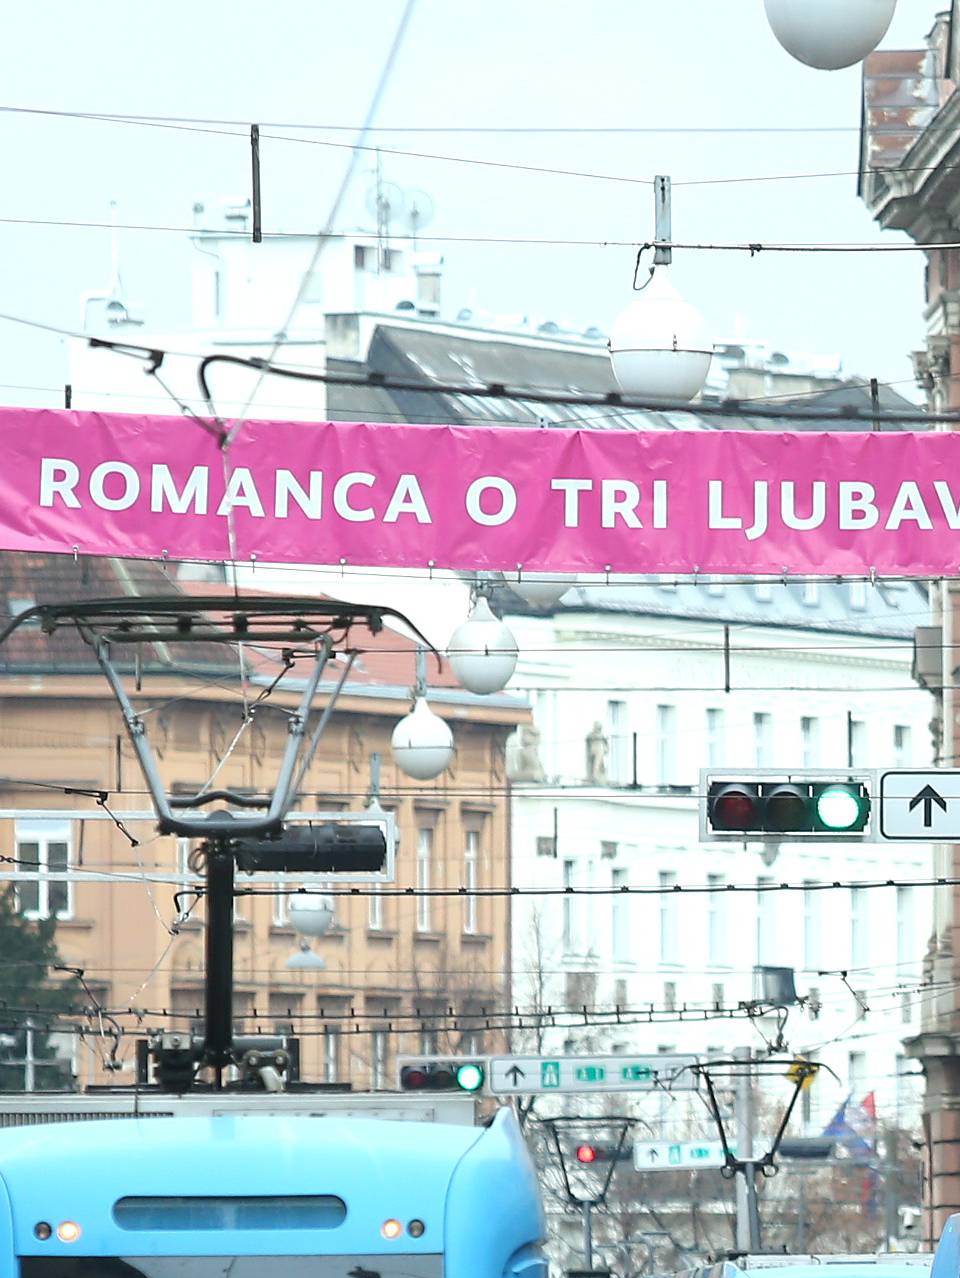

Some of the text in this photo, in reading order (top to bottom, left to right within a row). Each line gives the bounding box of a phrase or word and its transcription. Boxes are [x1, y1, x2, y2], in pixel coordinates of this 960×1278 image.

[38, 457, 433, 525] ROMANCA
[465, 476, 517, 526] O
[551, 478, 668, 529] TRI
